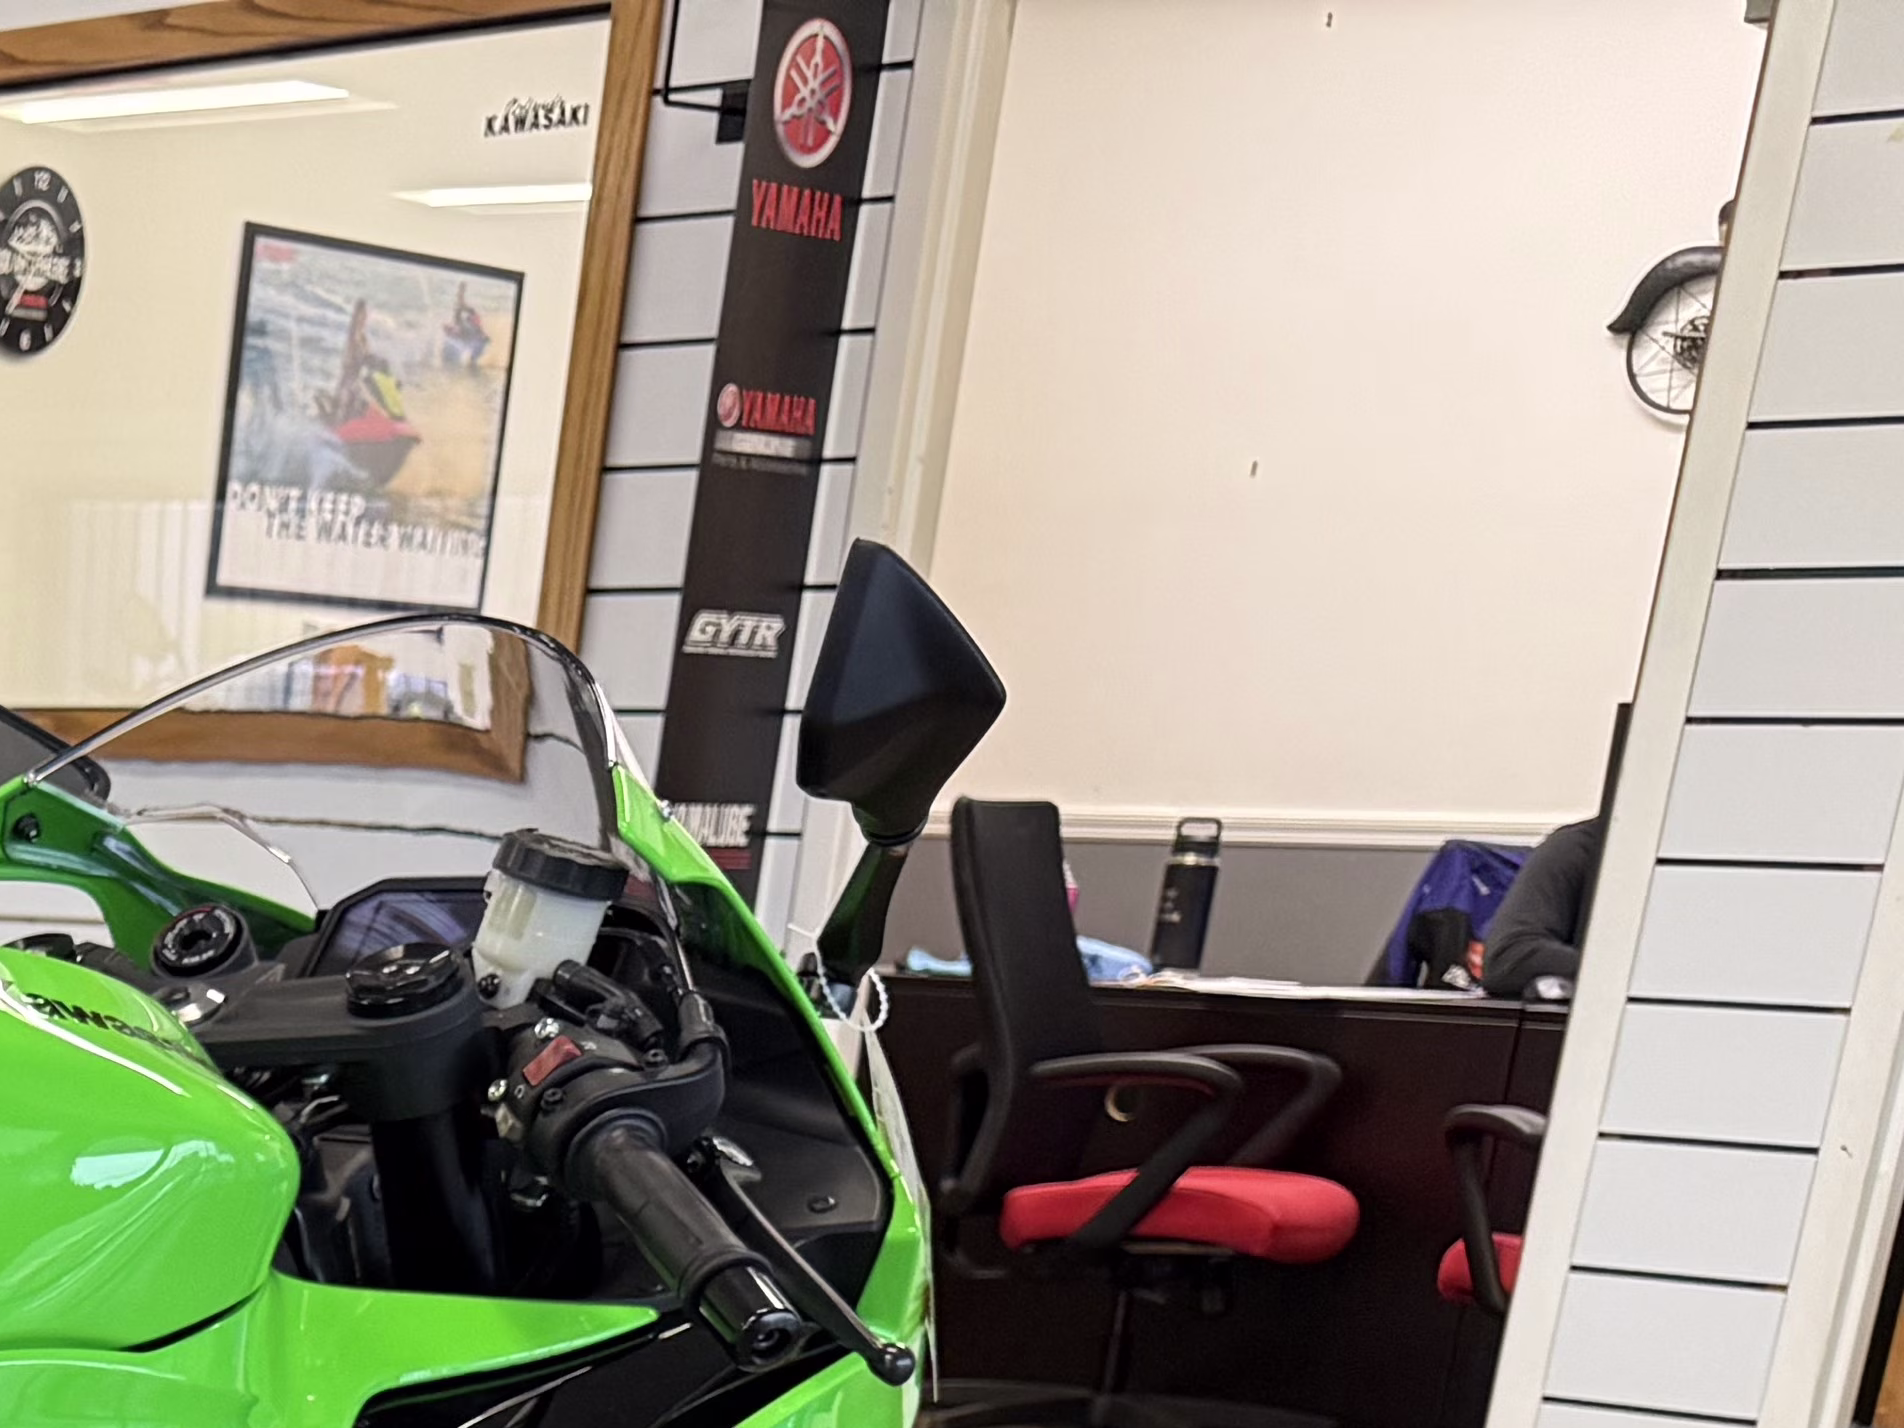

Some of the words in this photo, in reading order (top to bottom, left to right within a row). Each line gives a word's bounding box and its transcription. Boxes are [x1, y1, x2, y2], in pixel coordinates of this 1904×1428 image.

[483, 101, 590, 138] KAWASAKI
[751, 178, 843, 242] YAMAHA
[741, 388, 817, 436] YAMAHA
[265, 514, 306, 541] THE
[685, 610, 785, 651] GYTR
